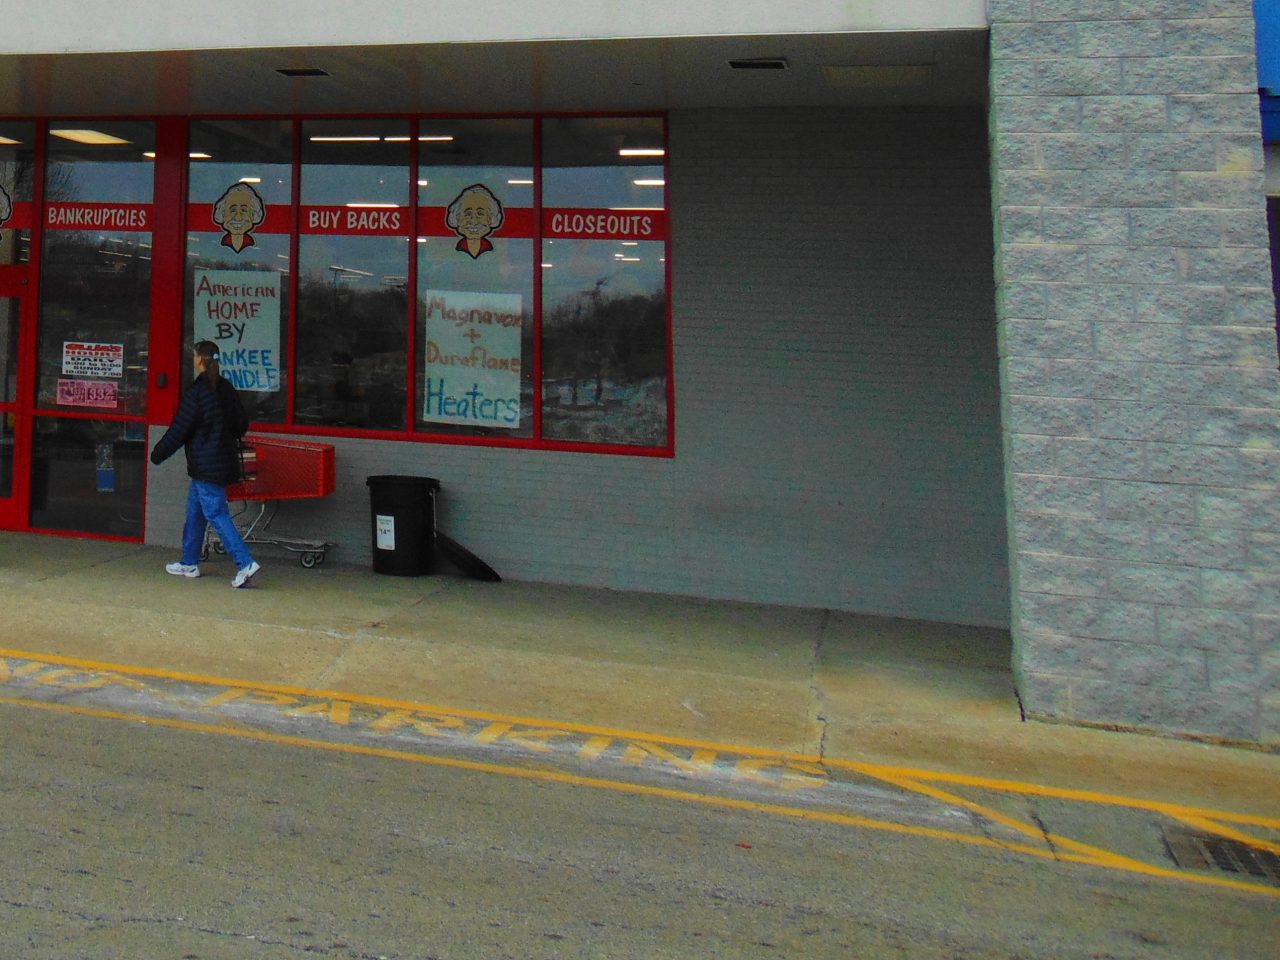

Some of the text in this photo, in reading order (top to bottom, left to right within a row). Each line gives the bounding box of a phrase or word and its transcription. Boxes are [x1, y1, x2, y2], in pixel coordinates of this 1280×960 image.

[48, 207, 147, 227] BANKRUPTCIES
[308, 210, 401, 230] BUY BACKS
[551, 213, 652, 235] CLOSEOUTS
[207, 300, 261, 319] HOME
[214, 323, 246, 344] BY
[426, 378, 519, 423] Heaters
